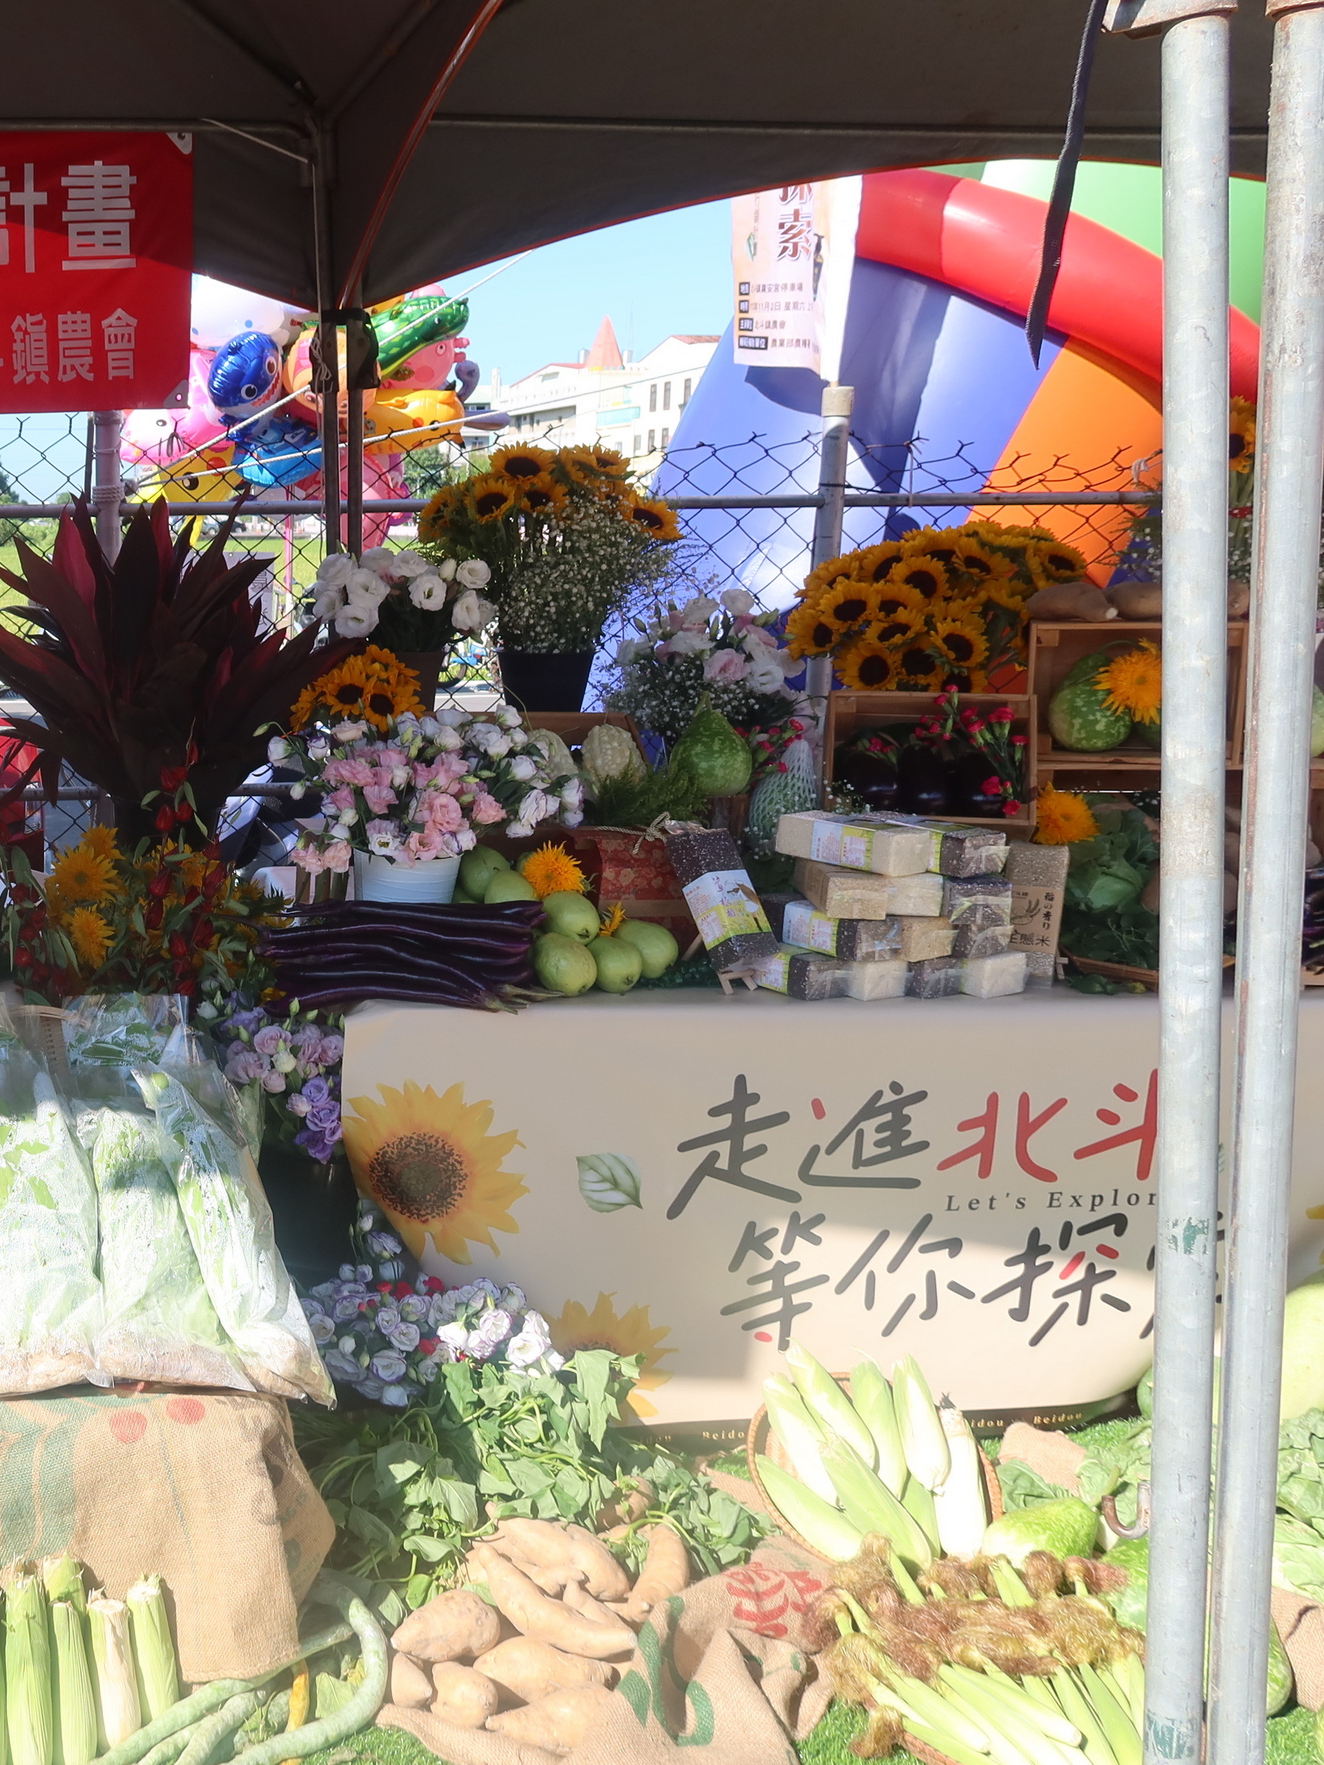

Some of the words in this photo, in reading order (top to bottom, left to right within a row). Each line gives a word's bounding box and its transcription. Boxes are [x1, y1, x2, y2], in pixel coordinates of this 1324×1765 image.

[667, 1068, 1158, 1220] 走進北斗
[945, 1192, 1027, 1212] Let's
[1046, 1188, 1158, 1212] Explor
[720, 1210, 1226, 1353] 等你探
[702, 1429, 745, 1441] Beido
[970, 1417, 1004, 1429] idou
[1032, 1412, 1084, 1426] Beidou
